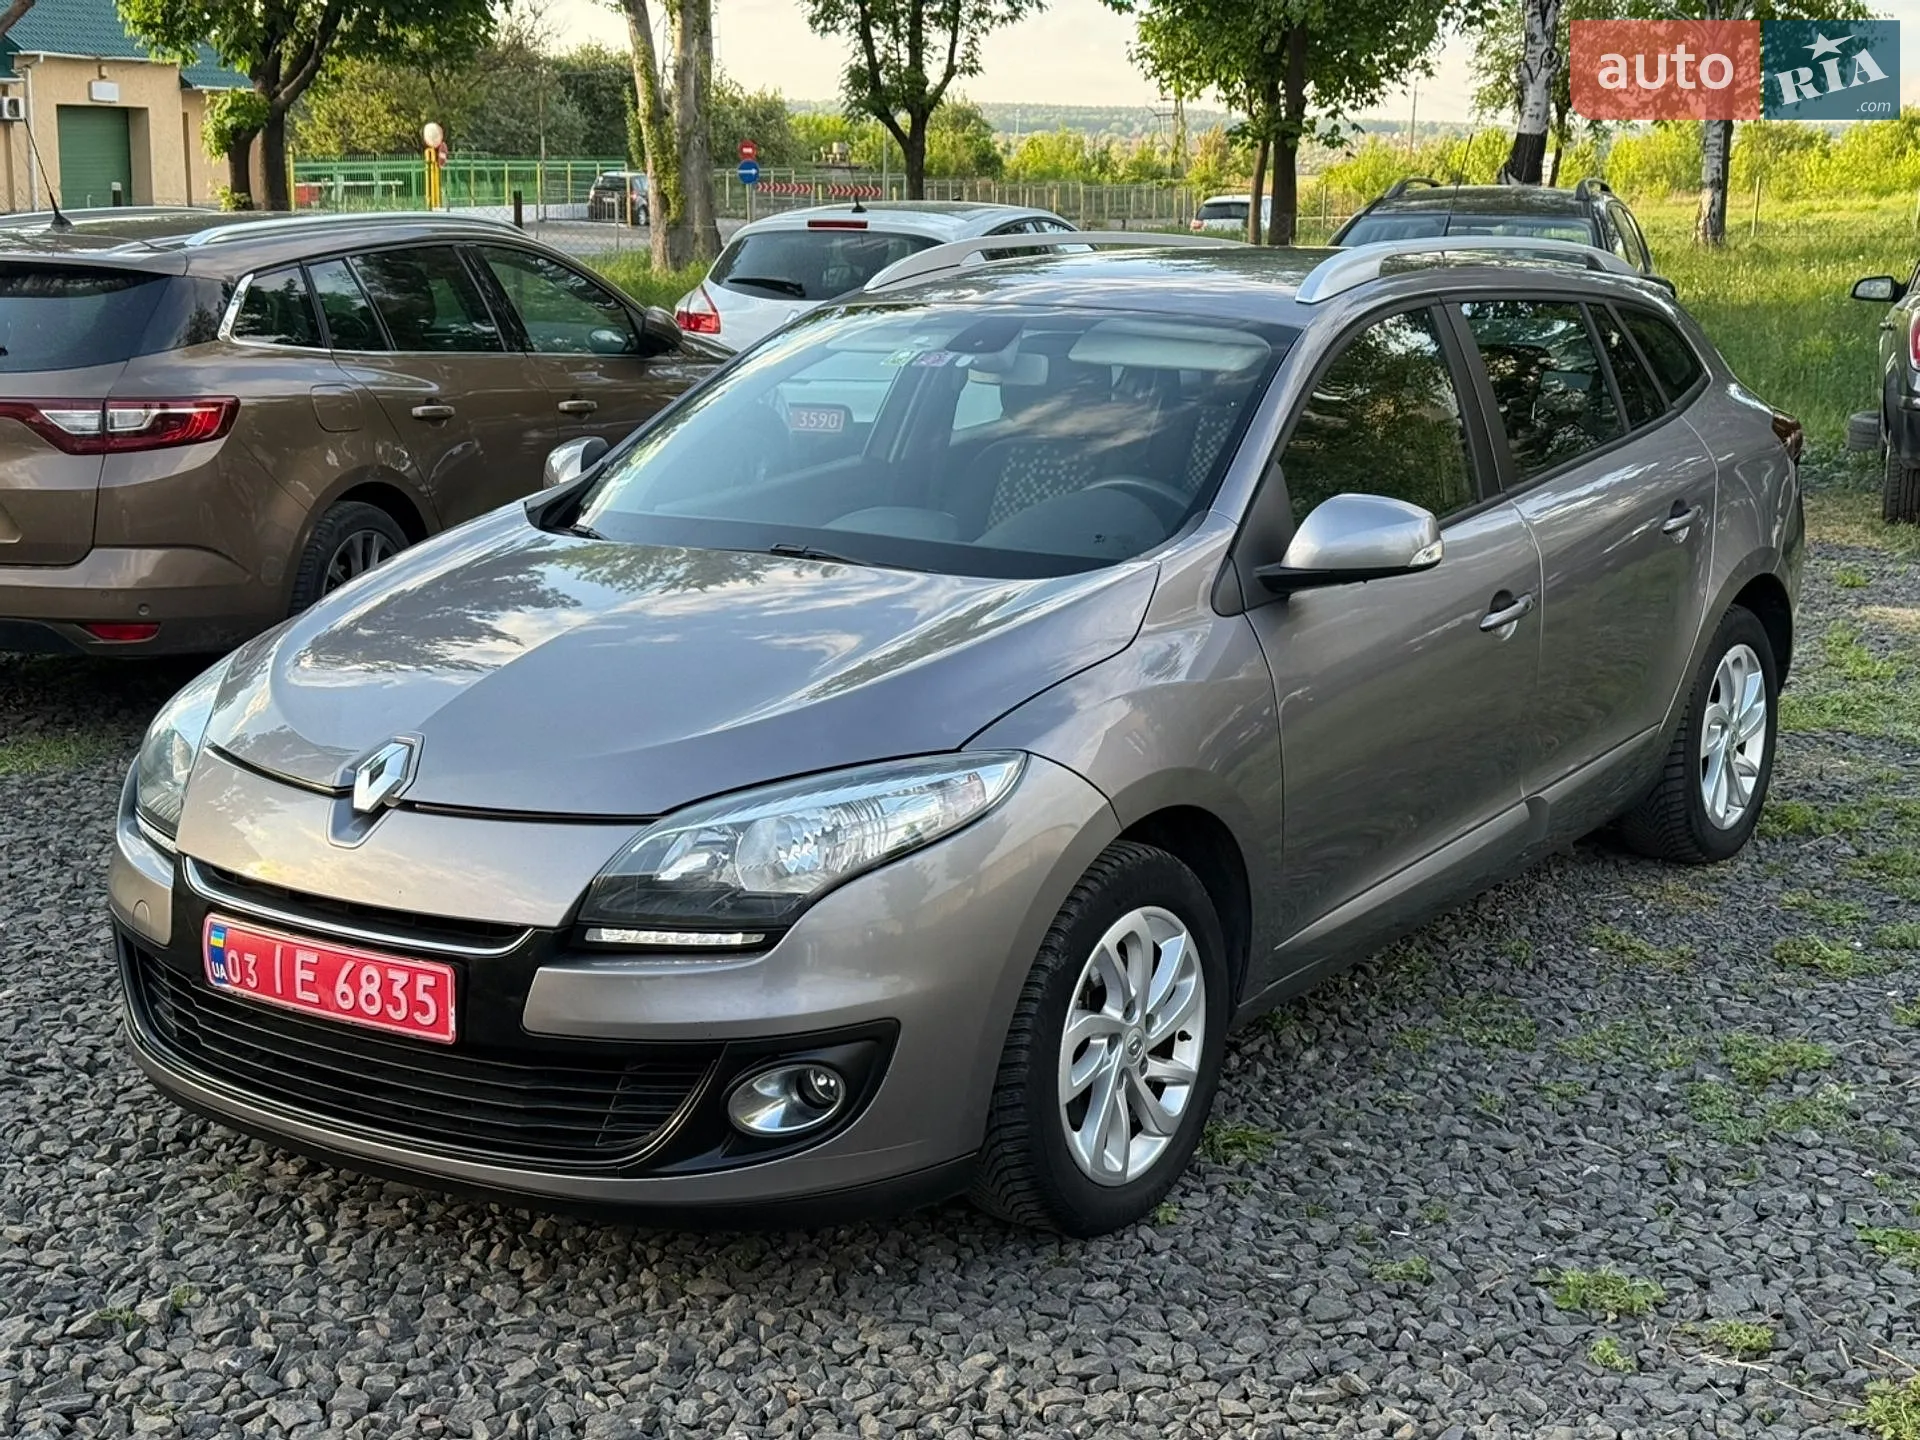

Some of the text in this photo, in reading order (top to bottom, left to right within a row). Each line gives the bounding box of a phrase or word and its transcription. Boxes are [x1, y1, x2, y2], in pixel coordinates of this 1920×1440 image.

[799, 411, 838, 428] 3590
[211, 961, 228, 980] UA
[227, 943, 437, 1026] 03 IE 6835
